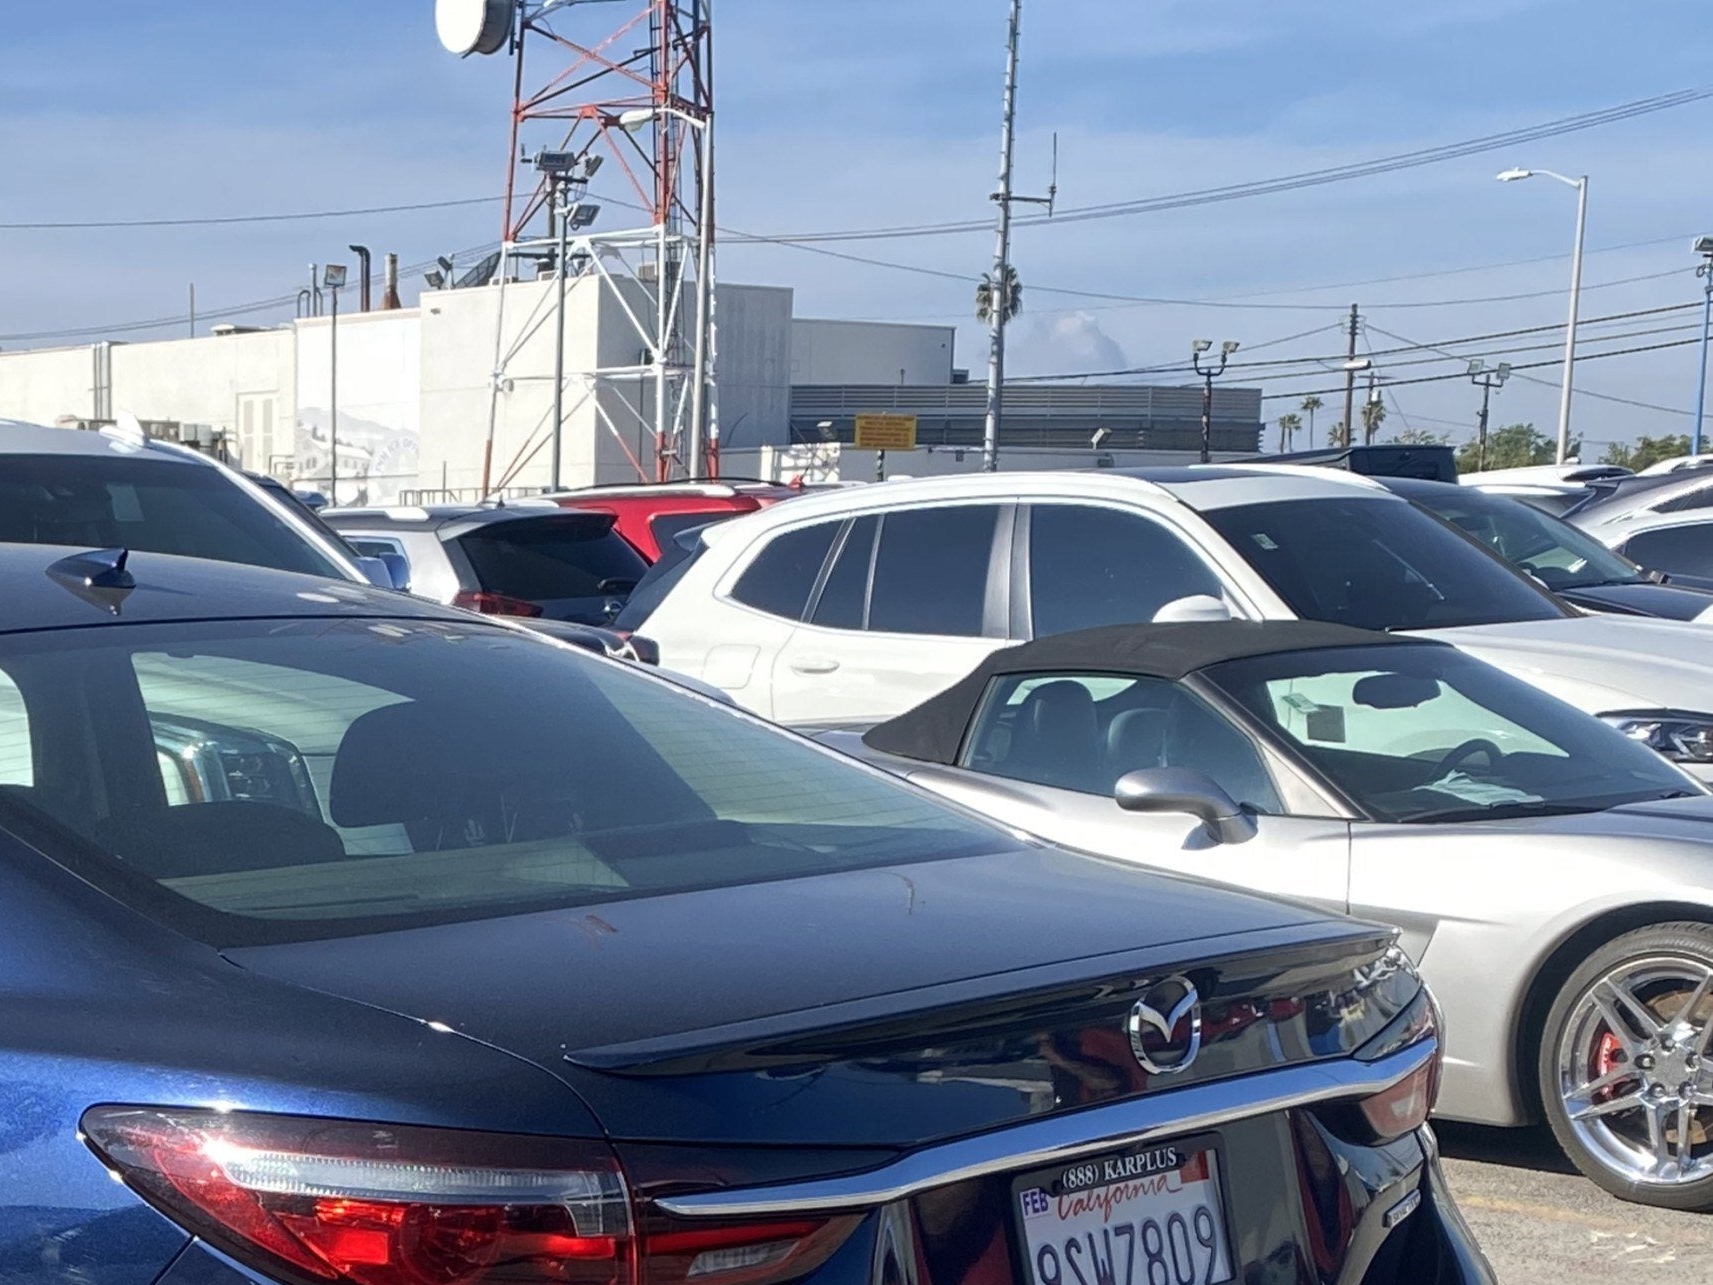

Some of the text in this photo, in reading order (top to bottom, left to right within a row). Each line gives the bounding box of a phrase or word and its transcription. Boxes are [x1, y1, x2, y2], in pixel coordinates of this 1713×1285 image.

[1062, 1147, 1177, 1189] (888) KARPLUS
[1023, 1189, 1049, 1216] FEB
[1057, 1174, 1182, 1223] California
